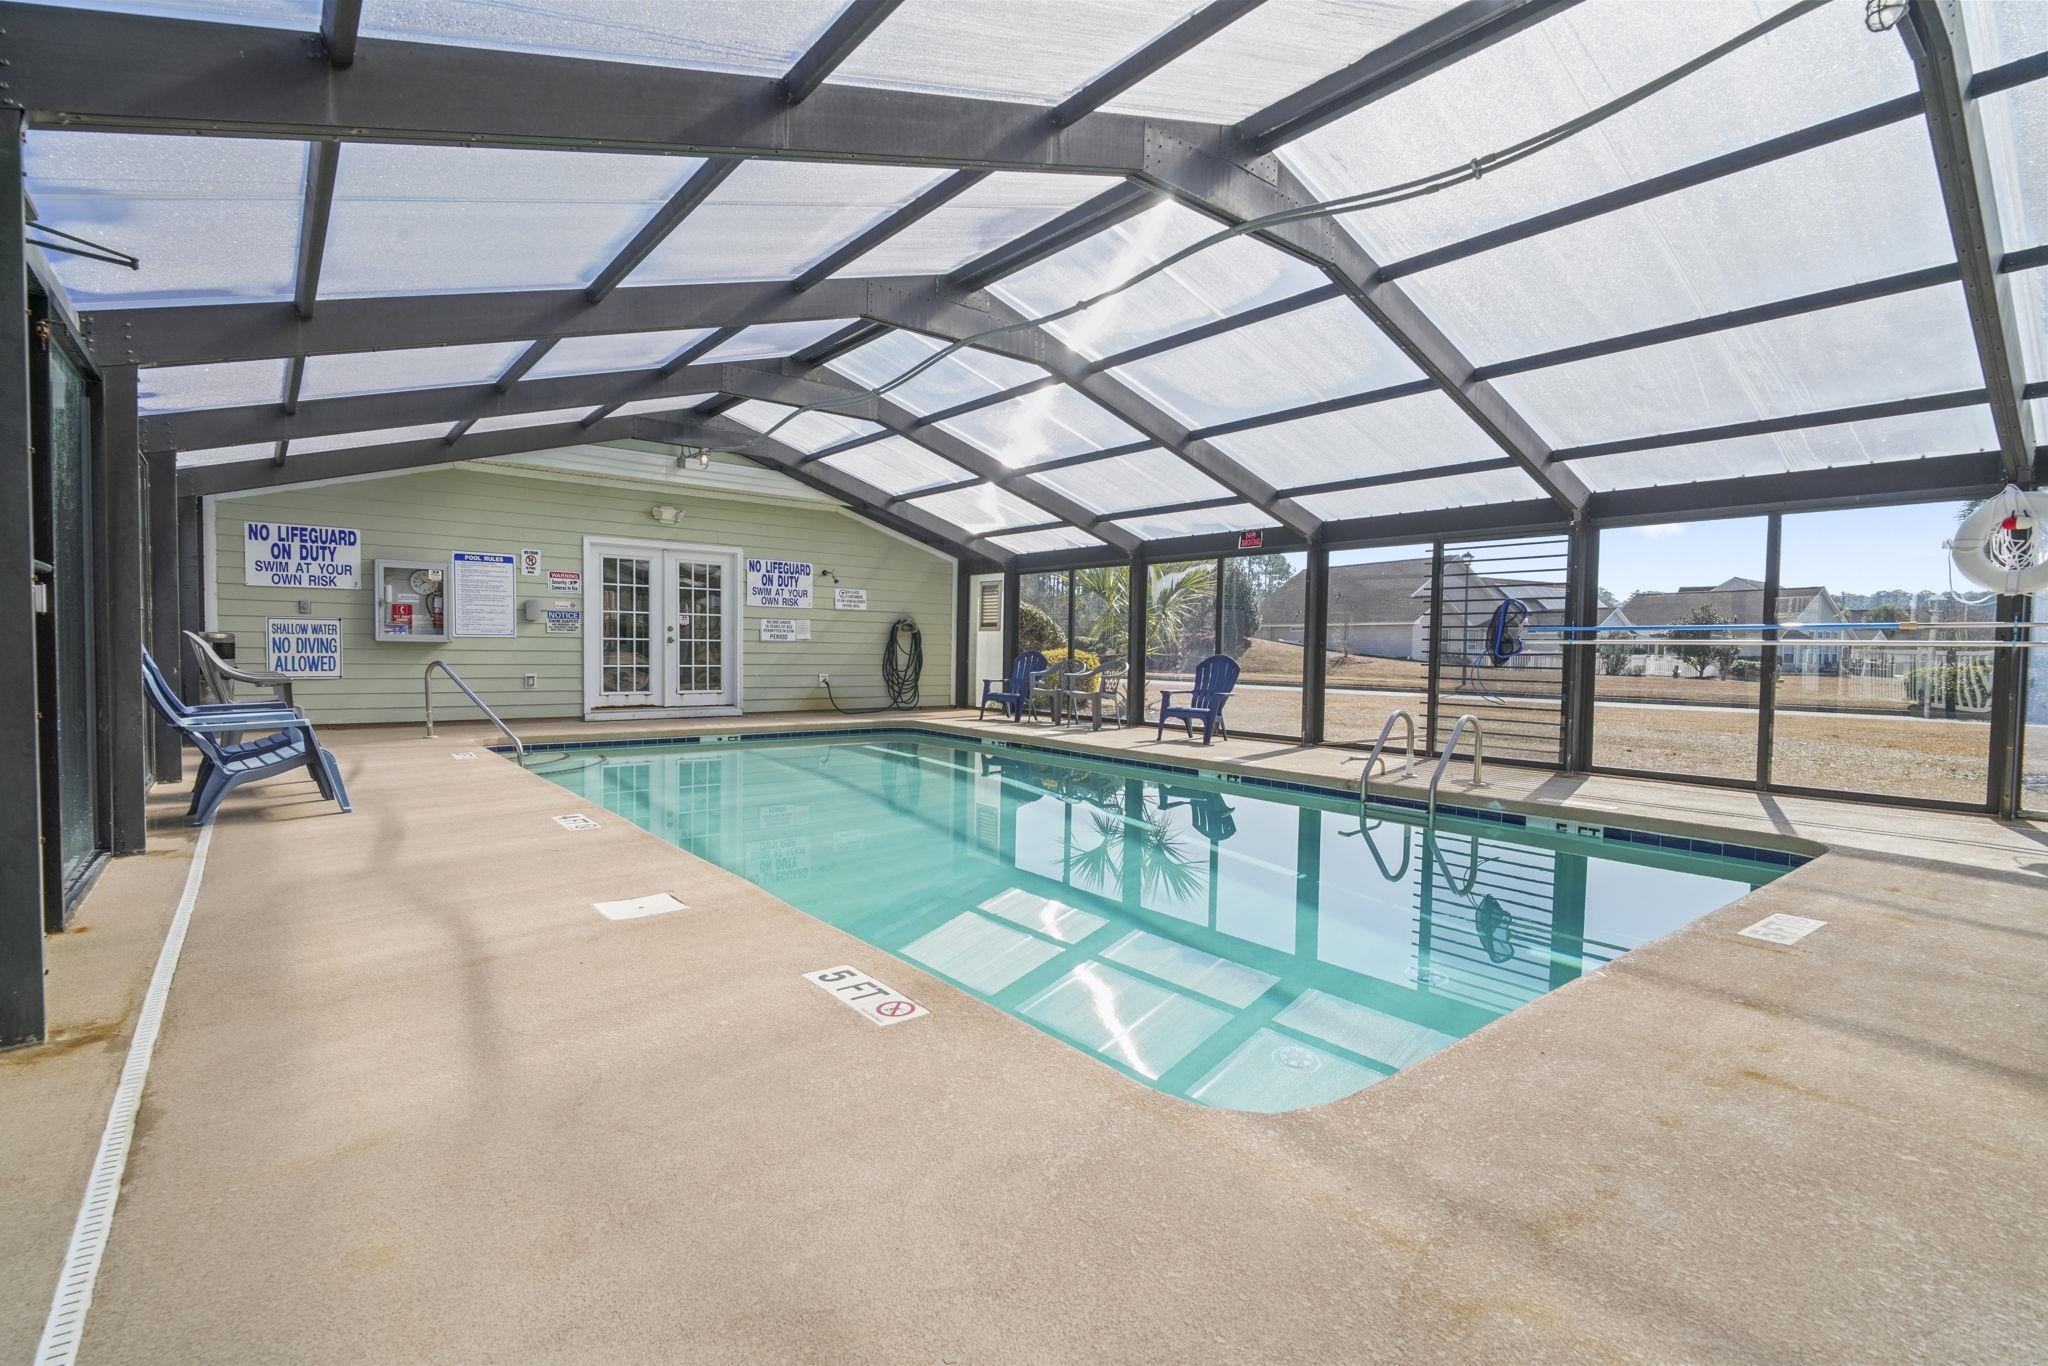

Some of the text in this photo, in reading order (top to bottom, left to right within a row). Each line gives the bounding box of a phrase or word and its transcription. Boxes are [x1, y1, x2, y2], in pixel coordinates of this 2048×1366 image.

[248, 524, 357, 547] NO LIFEGUARD
[271, 543, 337, 562] ON DUTY
[255, 560, 352, 576] SWIM AT YOUR
[749, 560, 811, 576] NO LIFEGUARD
[271, 573, 337, 587] OWN RISK
[761, 574, 799, 588] ON DUTY
[752, 586, 808, 598] SWIM AT YOUR
[761, 597, 799, 606] OWN RISK
[549, 611, 579, 619] NOTICE
[272, 623, 338, 635] SHALLOW WATER
[272, 637, 338, 653] NO DIVING
[275, 656, 336, 671] ALLOWED
[1578, 826, 1600, 836] FT
[818, 969, 891, 1000] 5 FT
